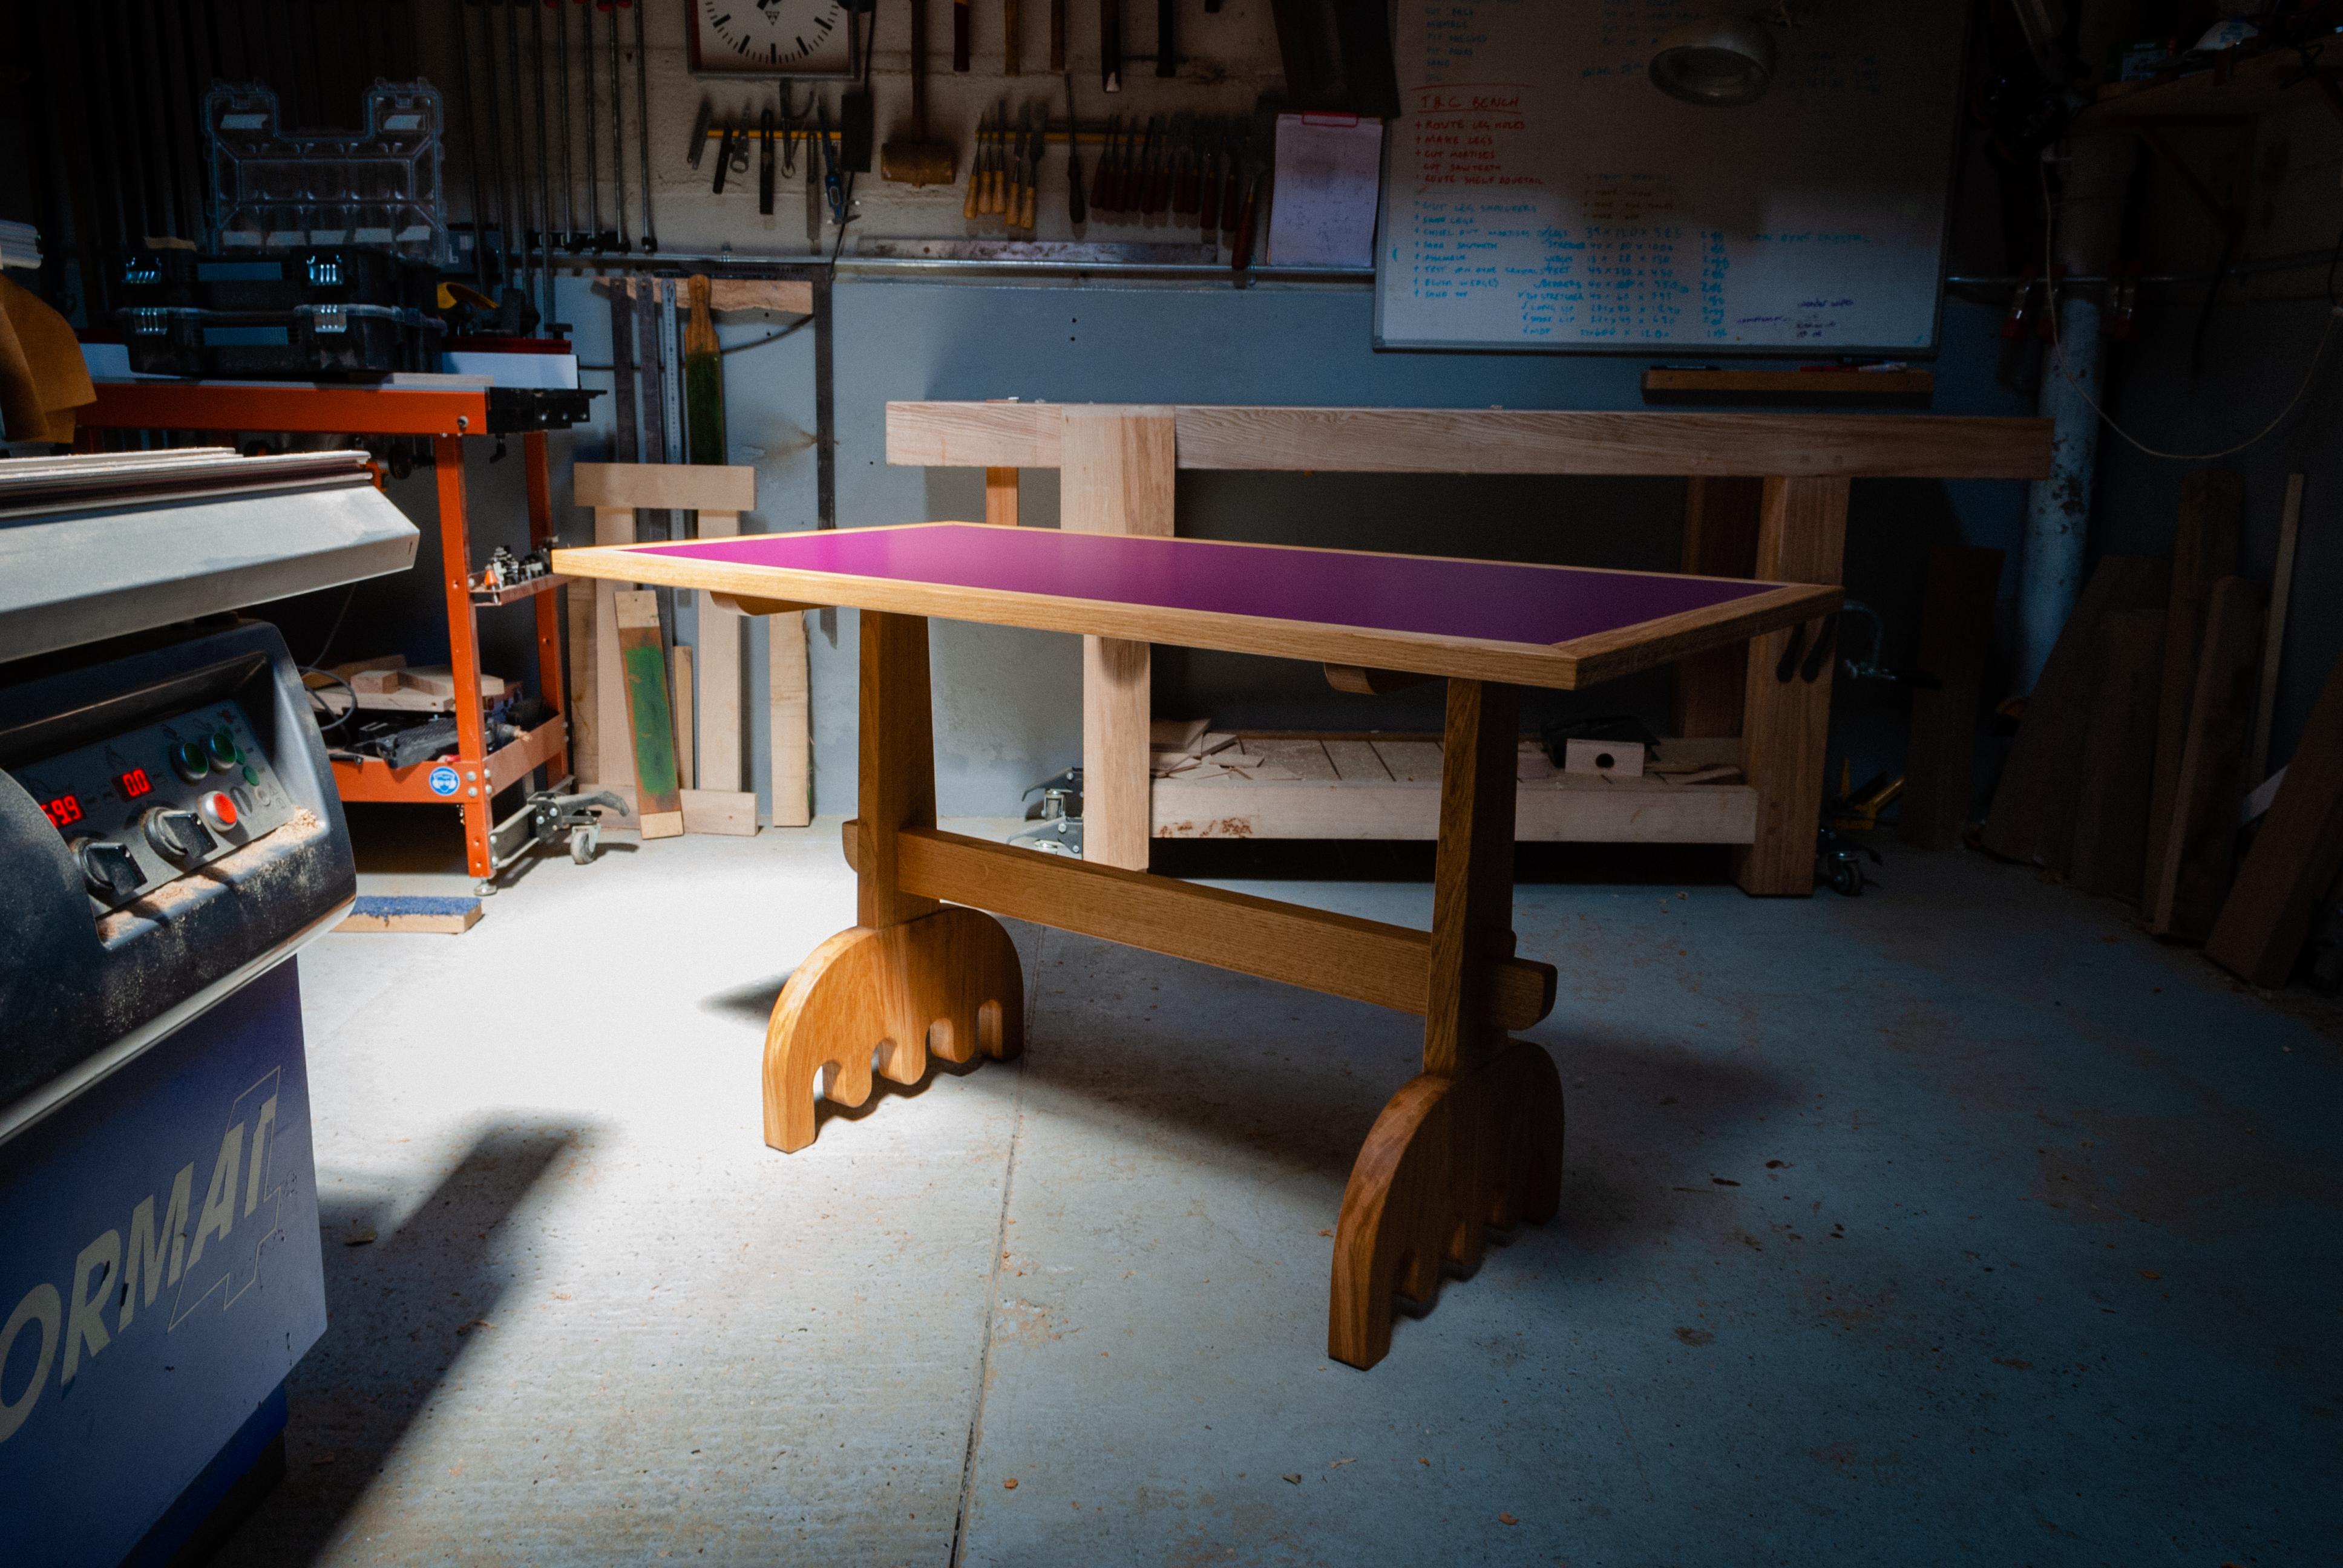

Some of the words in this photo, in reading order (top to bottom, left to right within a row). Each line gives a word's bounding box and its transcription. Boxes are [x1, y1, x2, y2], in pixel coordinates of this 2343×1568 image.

[1472, 96, 1519, 108] BENCH
[1425, 120, 1464, 129] ROUTE
[1425, 135, 1459, 145] MAKE
[1468, 136, 1493, 146] LEGS
